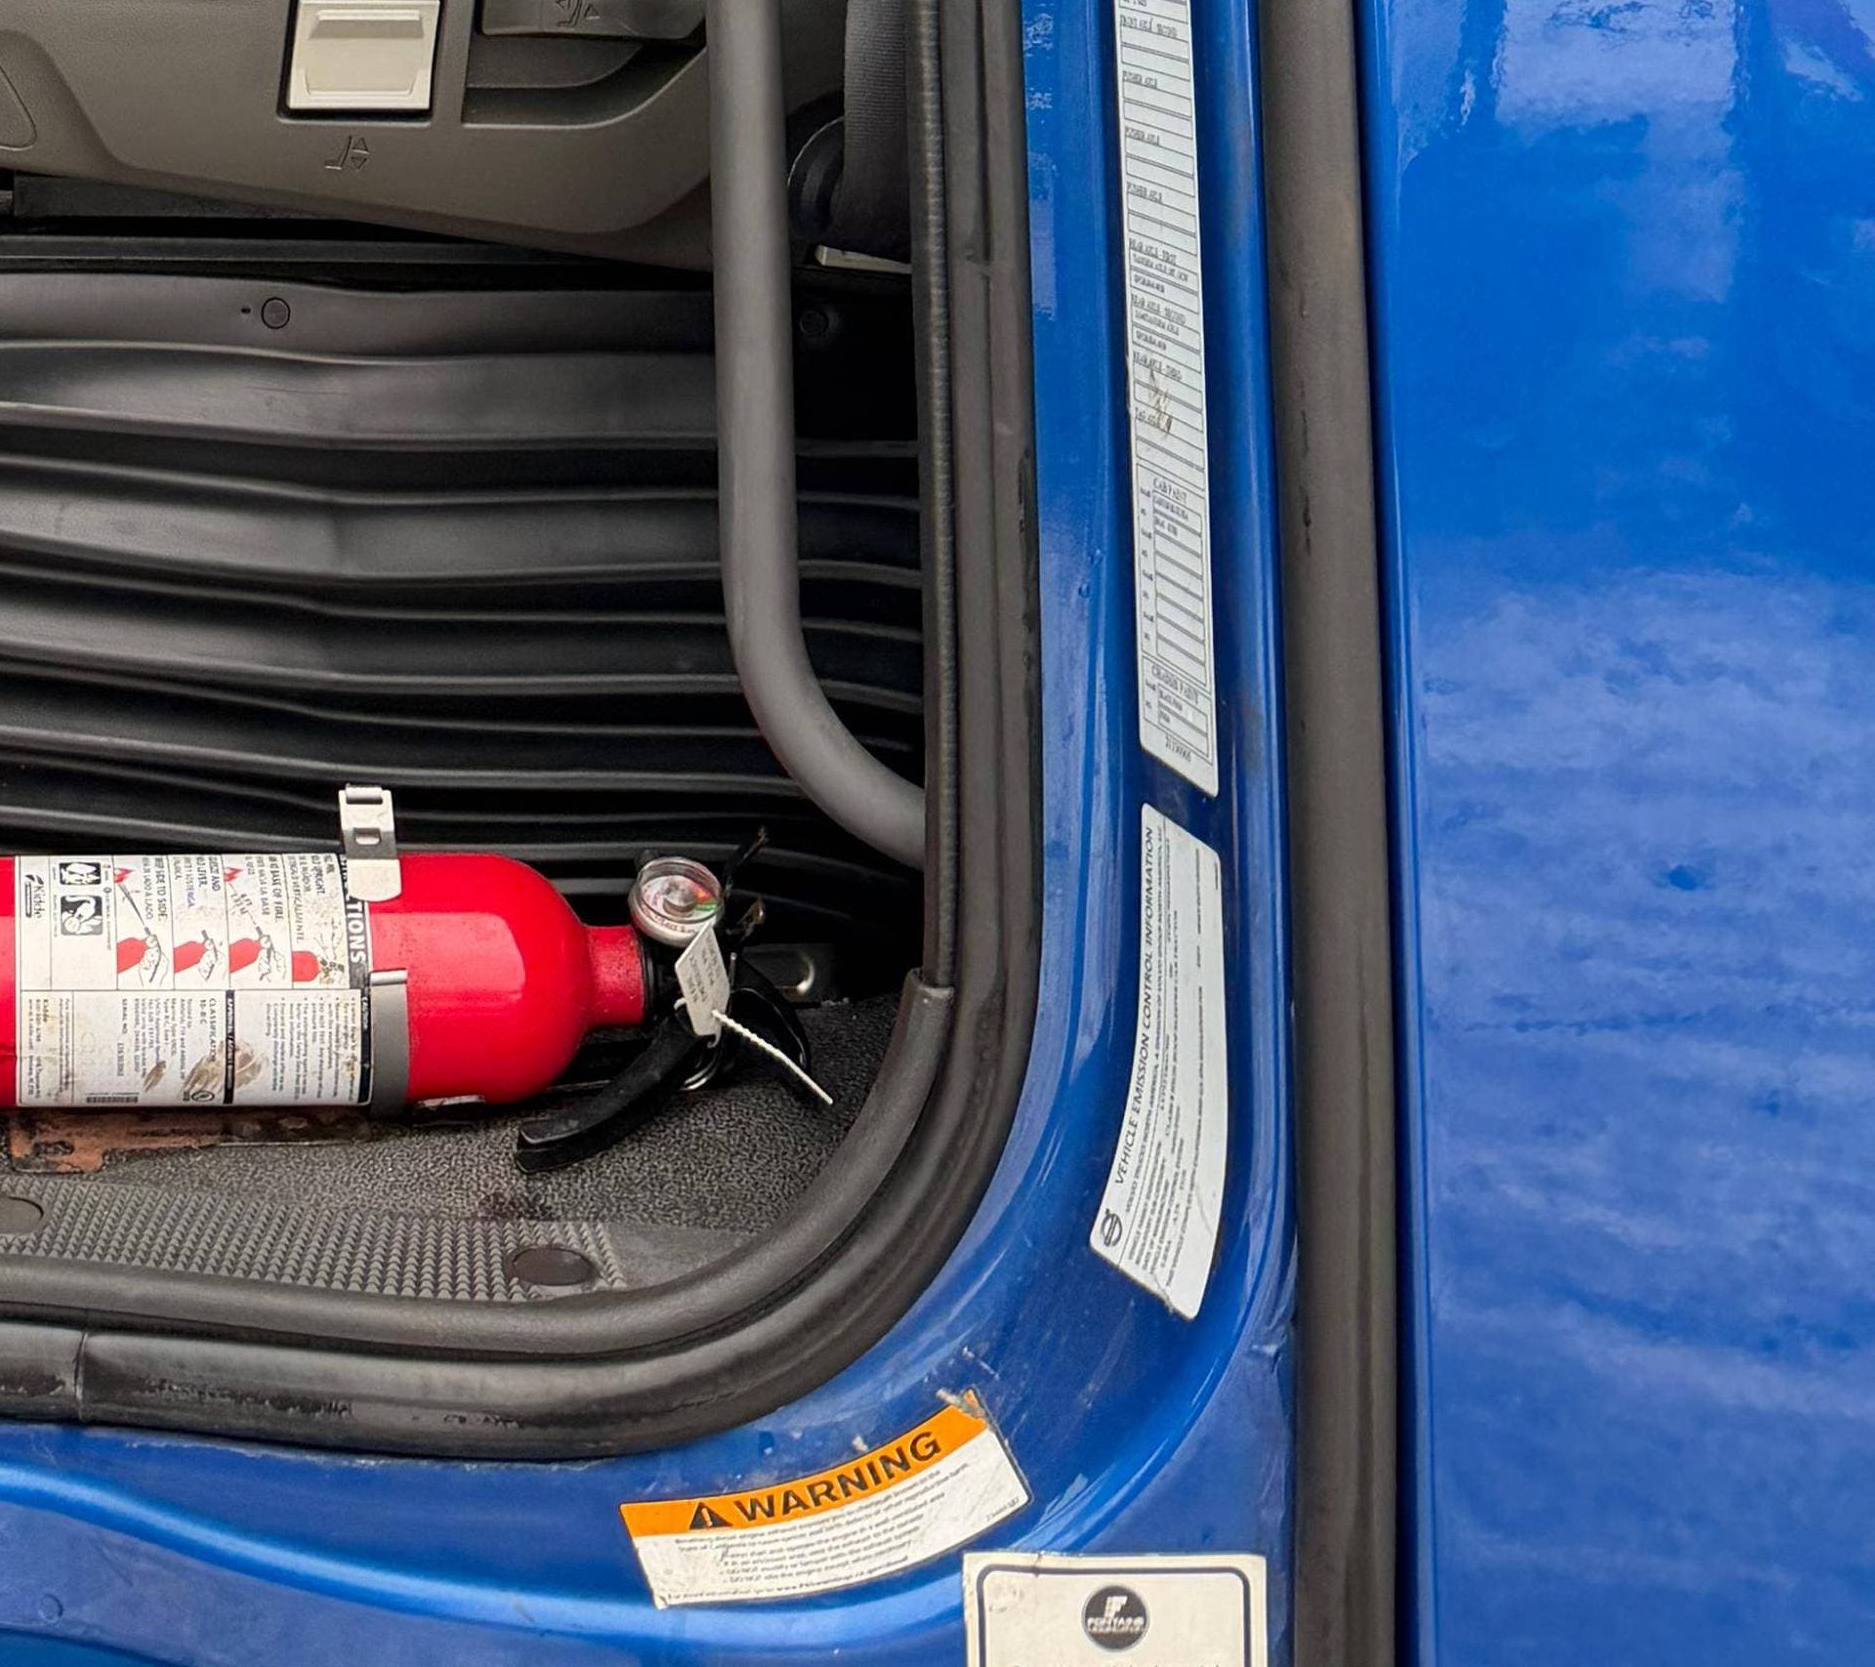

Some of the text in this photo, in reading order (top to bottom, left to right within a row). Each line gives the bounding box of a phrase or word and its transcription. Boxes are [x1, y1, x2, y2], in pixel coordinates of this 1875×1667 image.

[33, 885, 45, 919] Kidde
[157, 886, 166, 897] TO
[1115, 827, 1153, 1185] VEHICLE EMISSION CONTROL INFORMATION
[735, 1431, 942, 1522] WARNING
